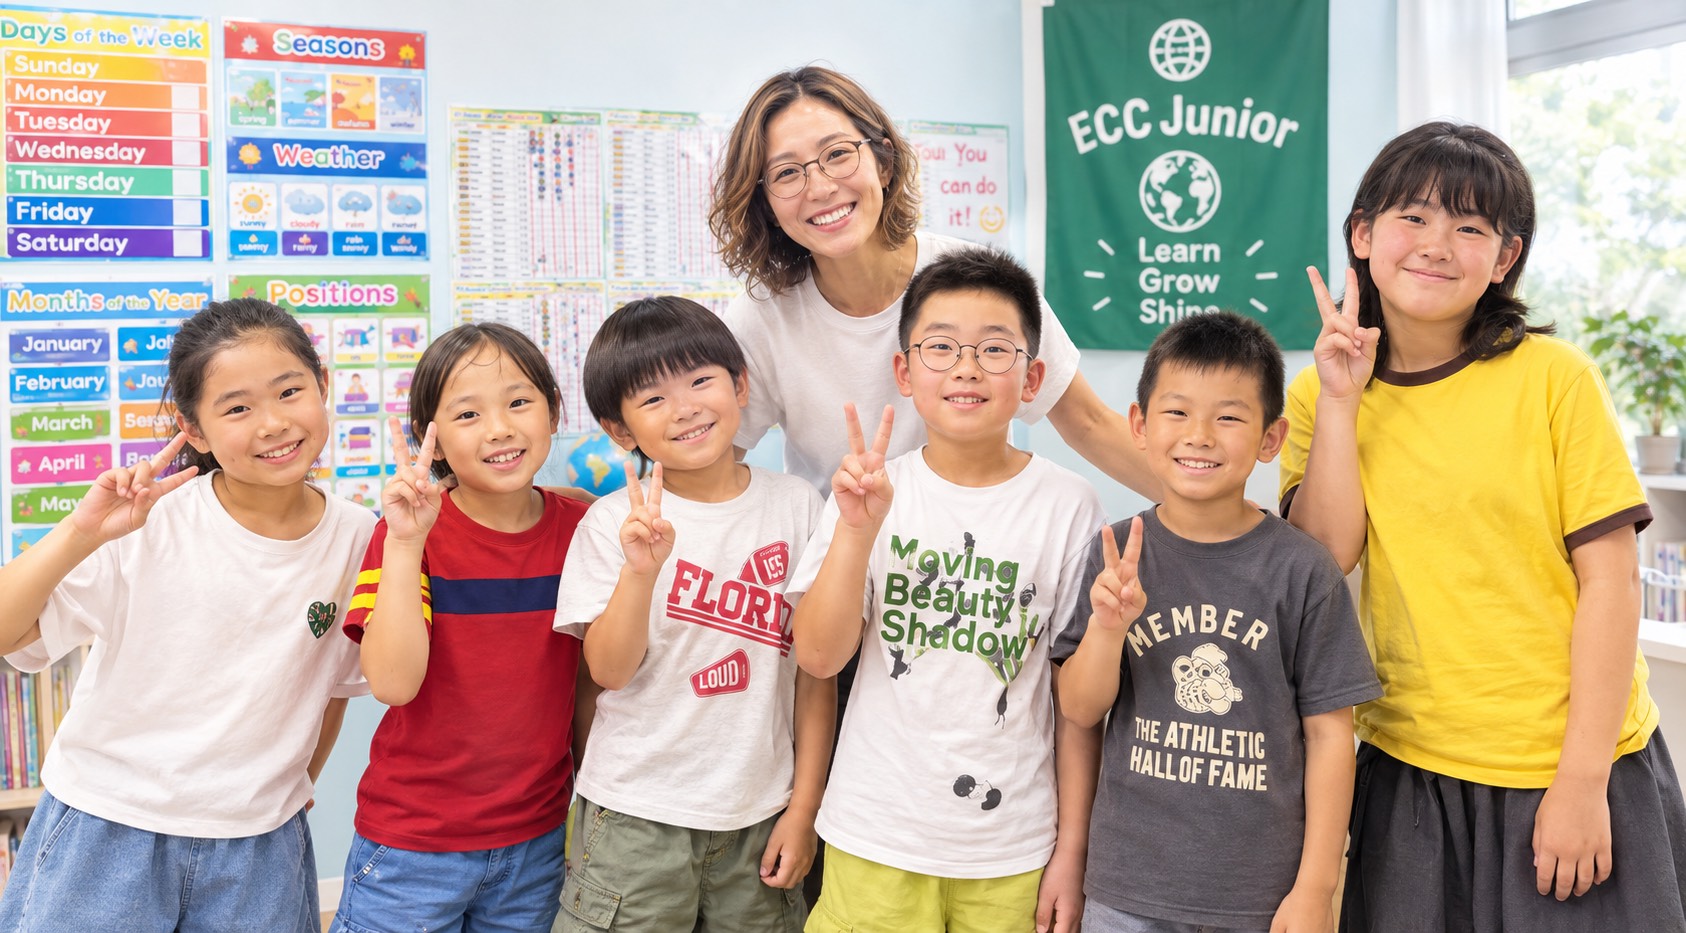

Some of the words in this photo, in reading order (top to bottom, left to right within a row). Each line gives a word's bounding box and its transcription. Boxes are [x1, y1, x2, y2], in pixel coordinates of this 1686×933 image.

[1, 20, 67, 44] Days
[74, 29, 92, 42] of
[100, 31, 127, 44] the
[133, 26, 202, 48] Week
[275, 31, 383, 57] Seasons
[15, 55, 99, 78] Sunday
[15, 83, 106, 106] Monday
[14, 111, 111, 134] Tuesday
[1068, 97, 1152, 154] ECC
[1159, 94, 1299, 148] Junior
[15, 140, 146, 164] Wednesday
[275, 145, 383, 168] Weather
[954, 143, 988, 167] You
[16, 170, 134, 195] Thursday
[941, 180, 971, 194] can
[976, 176, 997, 194] do
[16, 201, 94, 224] Friday
[949, 206, 971, 227] it!
[16, 233, 128, 257] Saturday
[1139, 236, 1221, 263] Learn
[269, 281, 396, 304] Positions
[1139, 267, 1221, 294] Grow
[9, 290, 104, 312] Months
[108, 296, 124, 309] of
[126, 295, 149, 309] the
[150, 290, 206, 310] Year
[22, 336, 103, 354] January
[15, 374, 105, 392] February
[32, 414, 93, 432] March
[38, 454, 85, 474] April
[41, 496, 82, 513] May
[890, 535, 1019, 594] Moving
[884, 572, 1015, 628] Beauty
[881, 609, 1028, 660] Shadow
[1126, 604, 1269, 657] MEMBER
[699, 659, 739, 689] LOUD
[1135, 716, 1161, 743] THE
[1164, 721, 1265, 760] ATHLETIC
[1129, 745, 1176, 781] HALL
[1179, 756, 1204, 784] OF
[1208, 759, 1267, 791] FAME
